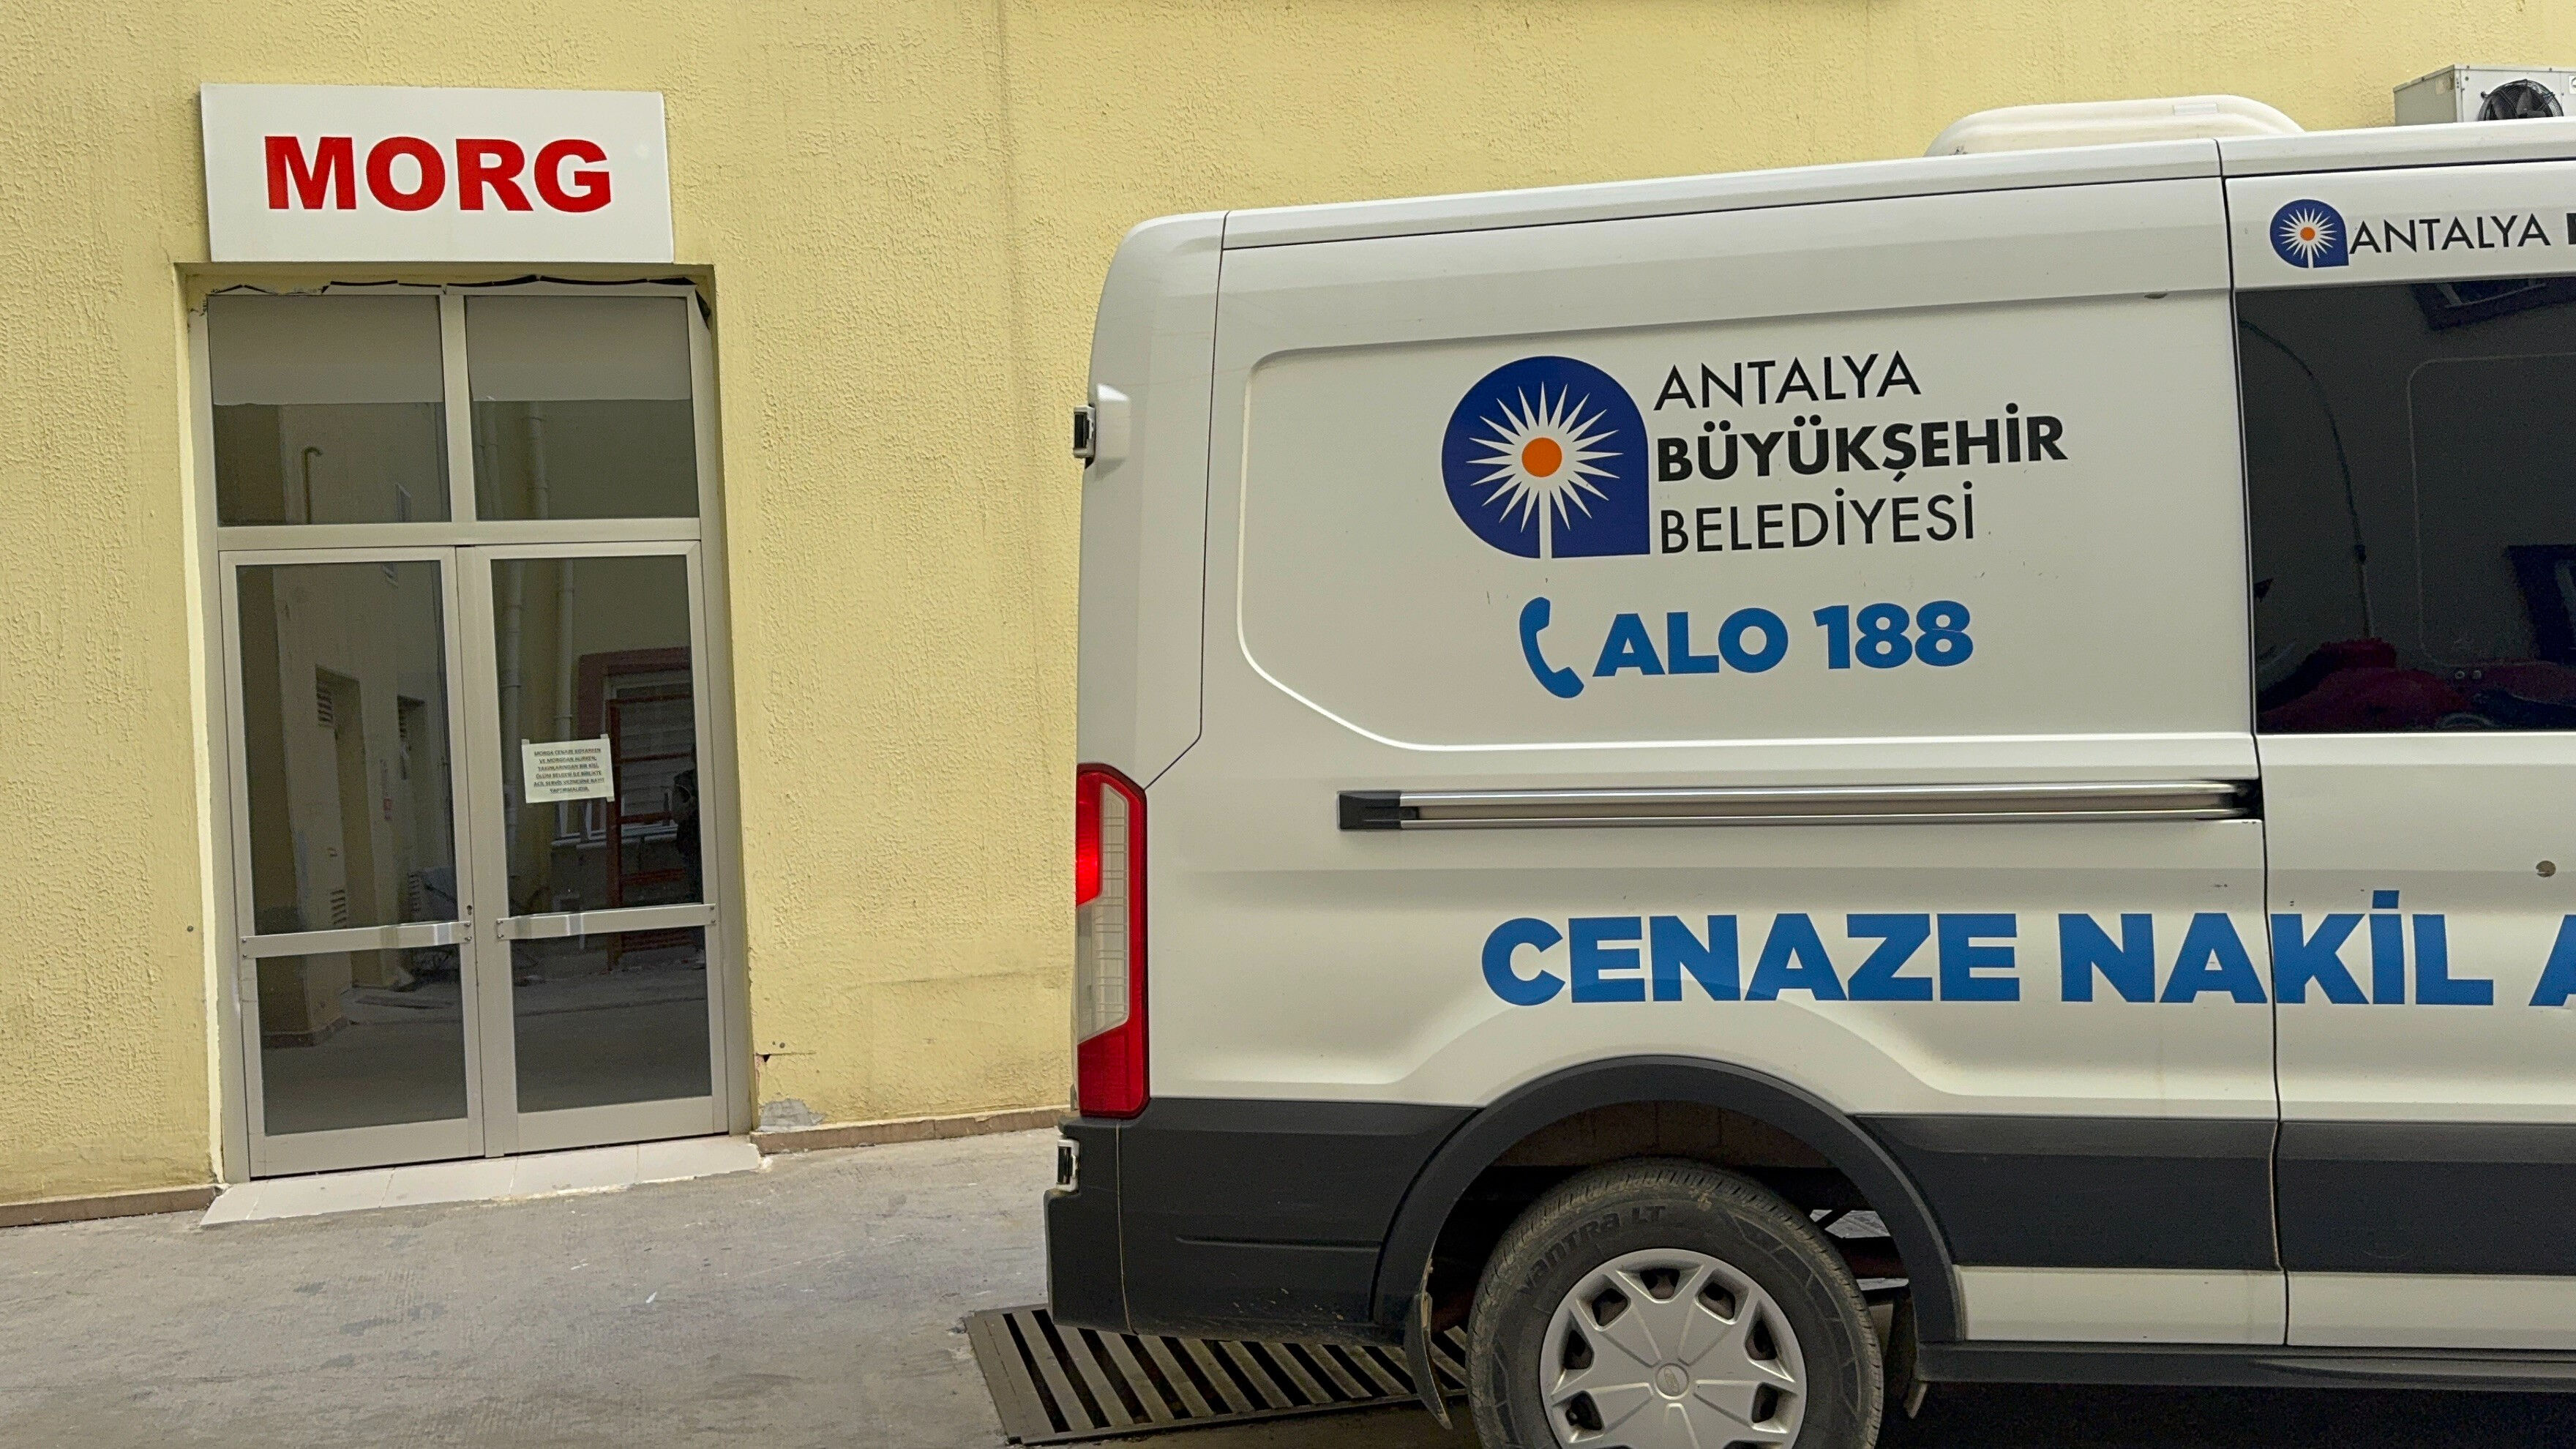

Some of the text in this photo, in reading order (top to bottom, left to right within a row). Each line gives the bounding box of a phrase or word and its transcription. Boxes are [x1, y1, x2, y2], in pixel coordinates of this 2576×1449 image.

[264, 135, 611, 212] MORG
[2348, 213, 2551, 254] ANTALYA
[1653, 350, 1922, 411] ANTALYA
[1658, 402, 2068, 483] BÜYÜKŞEHİR
[1660, 480, 1975, 554] BELEDİYESİ
[1592, 599, 1974, 677] ALO 188
[1481, 913, 2021, 1006] CENAZE
[2058, 890, 2494, 1006] NAKİL
